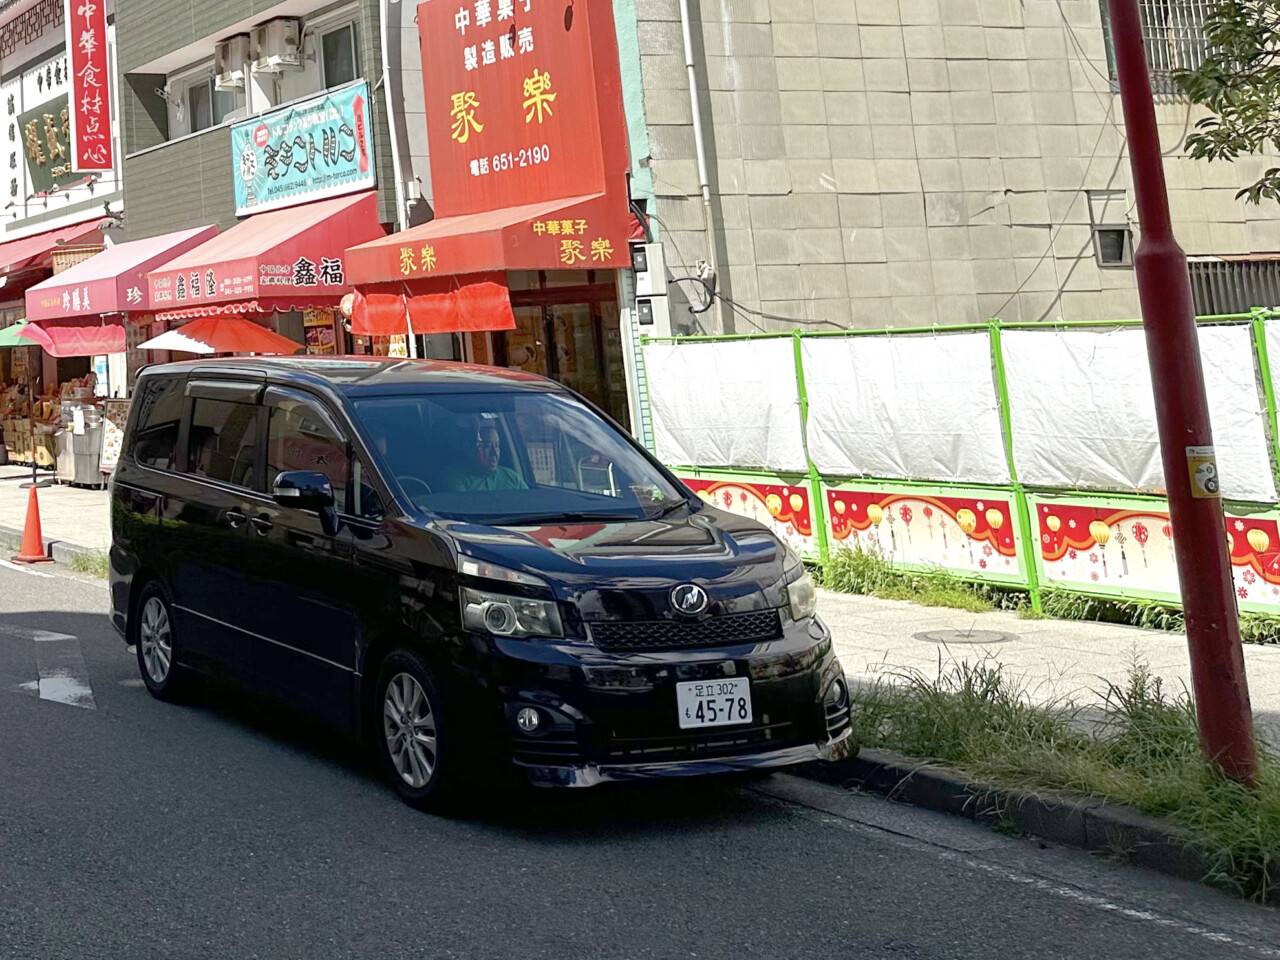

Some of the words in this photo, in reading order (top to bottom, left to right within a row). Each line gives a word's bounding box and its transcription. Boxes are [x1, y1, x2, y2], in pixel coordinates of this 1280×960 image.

[463, 27, 534, 71] 製造販売
[76, 0, 108, 164] 中華食材点心
[470, 157, 489, 177] 電話
[492, 144, 550, 172] 651-2190
[533, 219, 588, 236] 中華菓子
[126, 285, 143, 305] 珍
[695, 684, 715, 697] 足立
[716, 682, 734, 696] 302
[695, 697, 748, 723] 45-78
